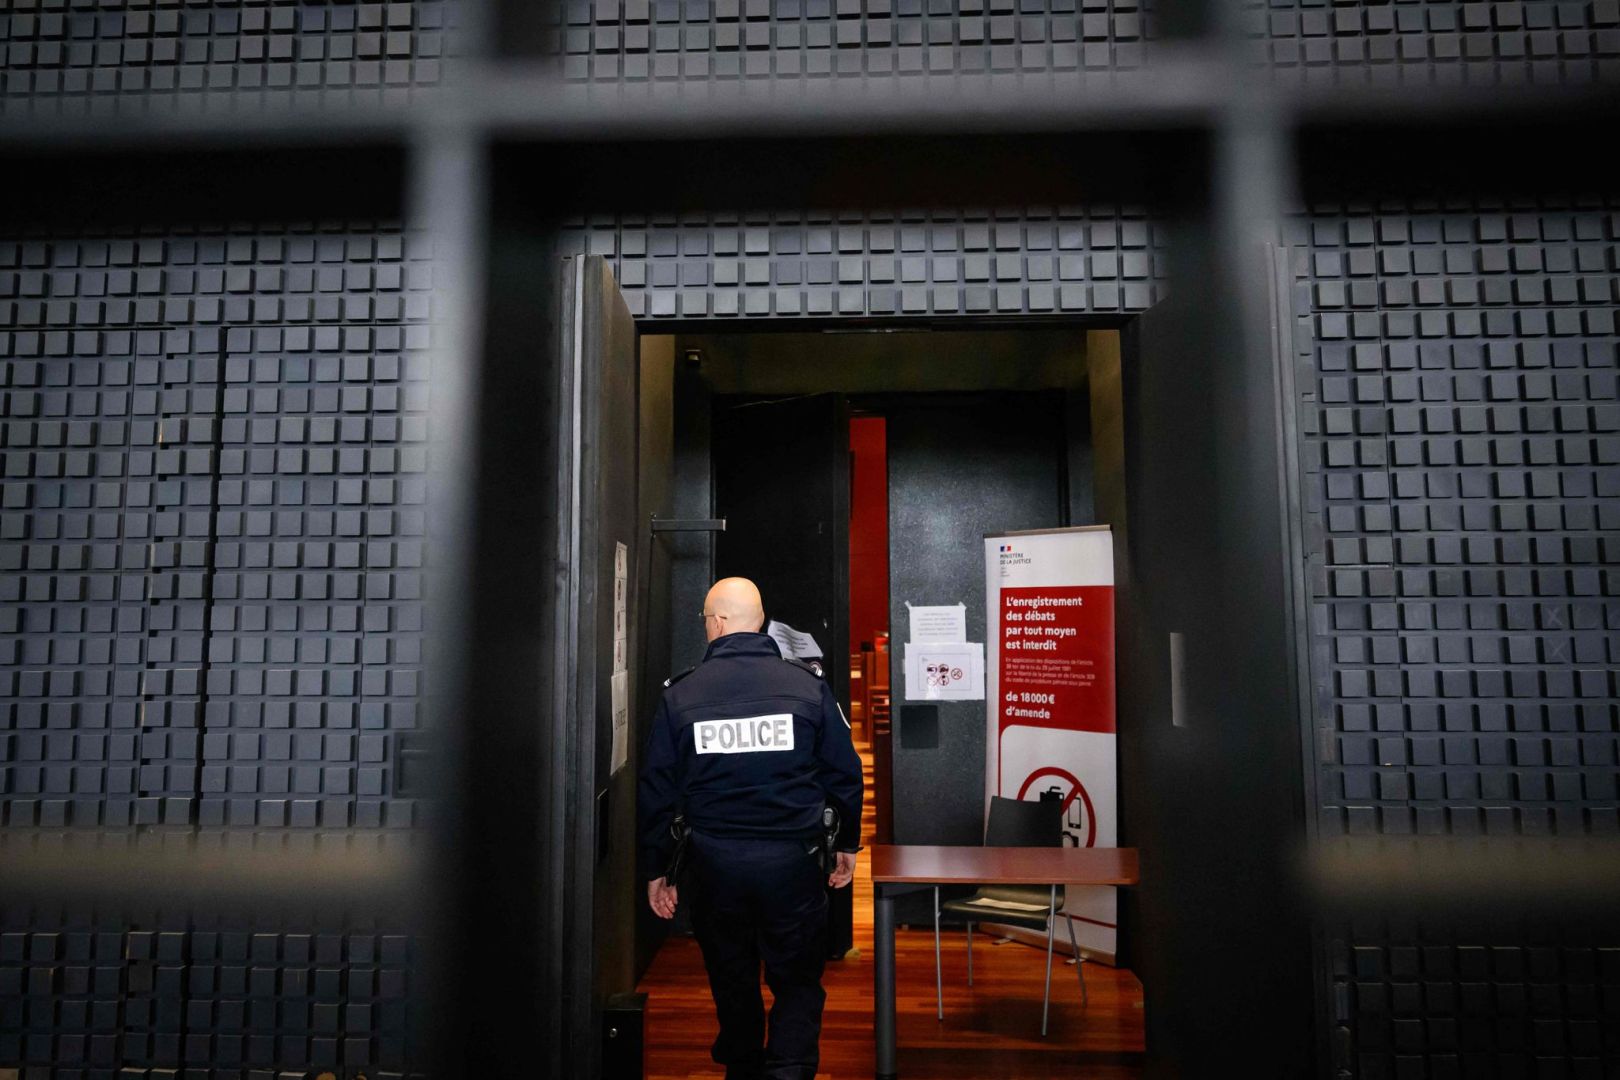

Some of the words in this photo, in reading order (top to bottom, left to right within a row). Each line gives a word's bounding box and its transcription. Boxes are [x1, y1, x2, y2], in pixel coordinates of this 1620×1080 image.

[1006, 596, 1082, 609] L'enregistrement
[1006, 610, 1022, 621] des
[1025, 610, 1055, 621] débats
[1006, 627, 1022, 637] par
[1024, 626, 1042, 635] tout
[1045, 628, 1076, 638] moyen
[1006, 640, 1020, 649] est
[1023, 639, 1056, 650] interdit
[1006, 691, 1018, 702] de
[1006, 705, 1050, 719] d'amende
[700, 719, 788, 750] POLICE
